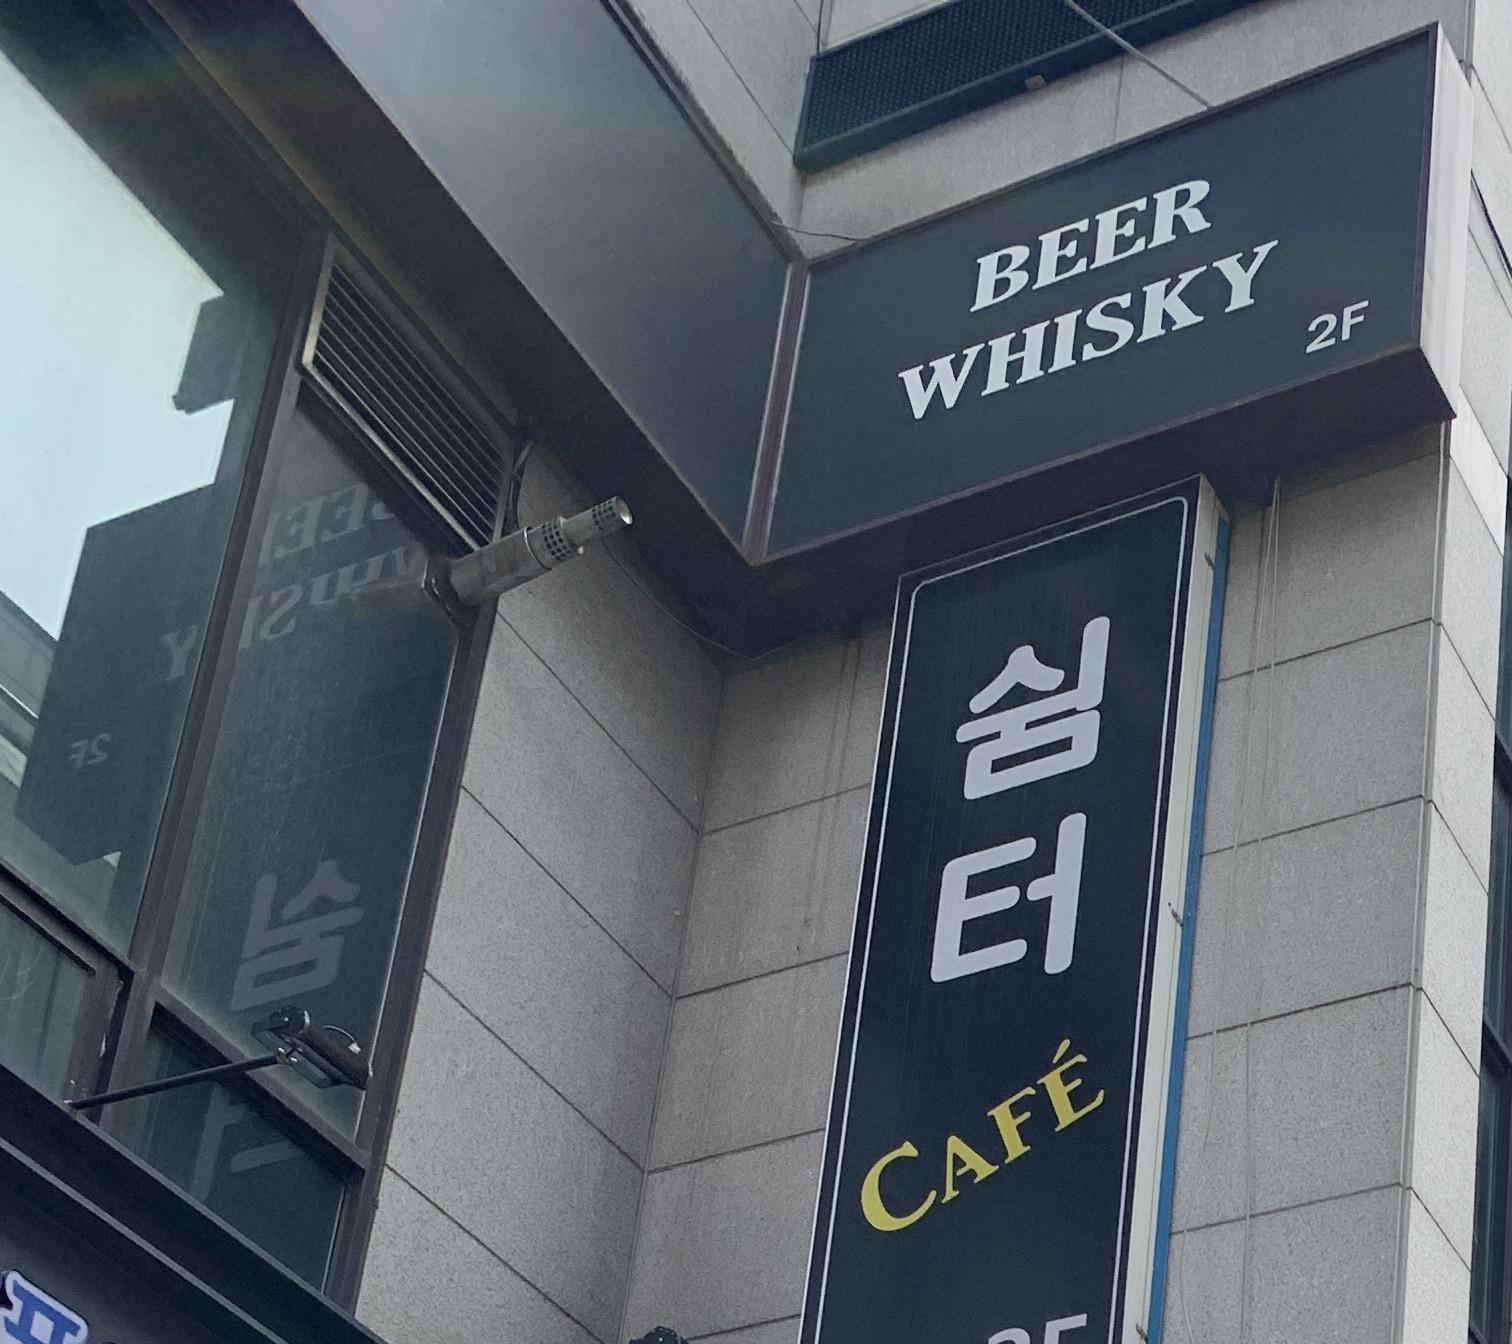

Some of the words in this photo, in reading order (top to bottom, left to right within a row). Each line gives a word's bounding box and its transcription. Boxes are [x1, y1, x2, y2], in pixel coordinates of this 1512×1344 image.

[898, 241, 1279, 420] WHISKY
[970, 178, 1211, 312] BEER
[1305, 300, 1369, 353] 2F
[930, 616, 1110, 982] 쉼터
[860, 1039, 1105, 1232] CAFÉ
